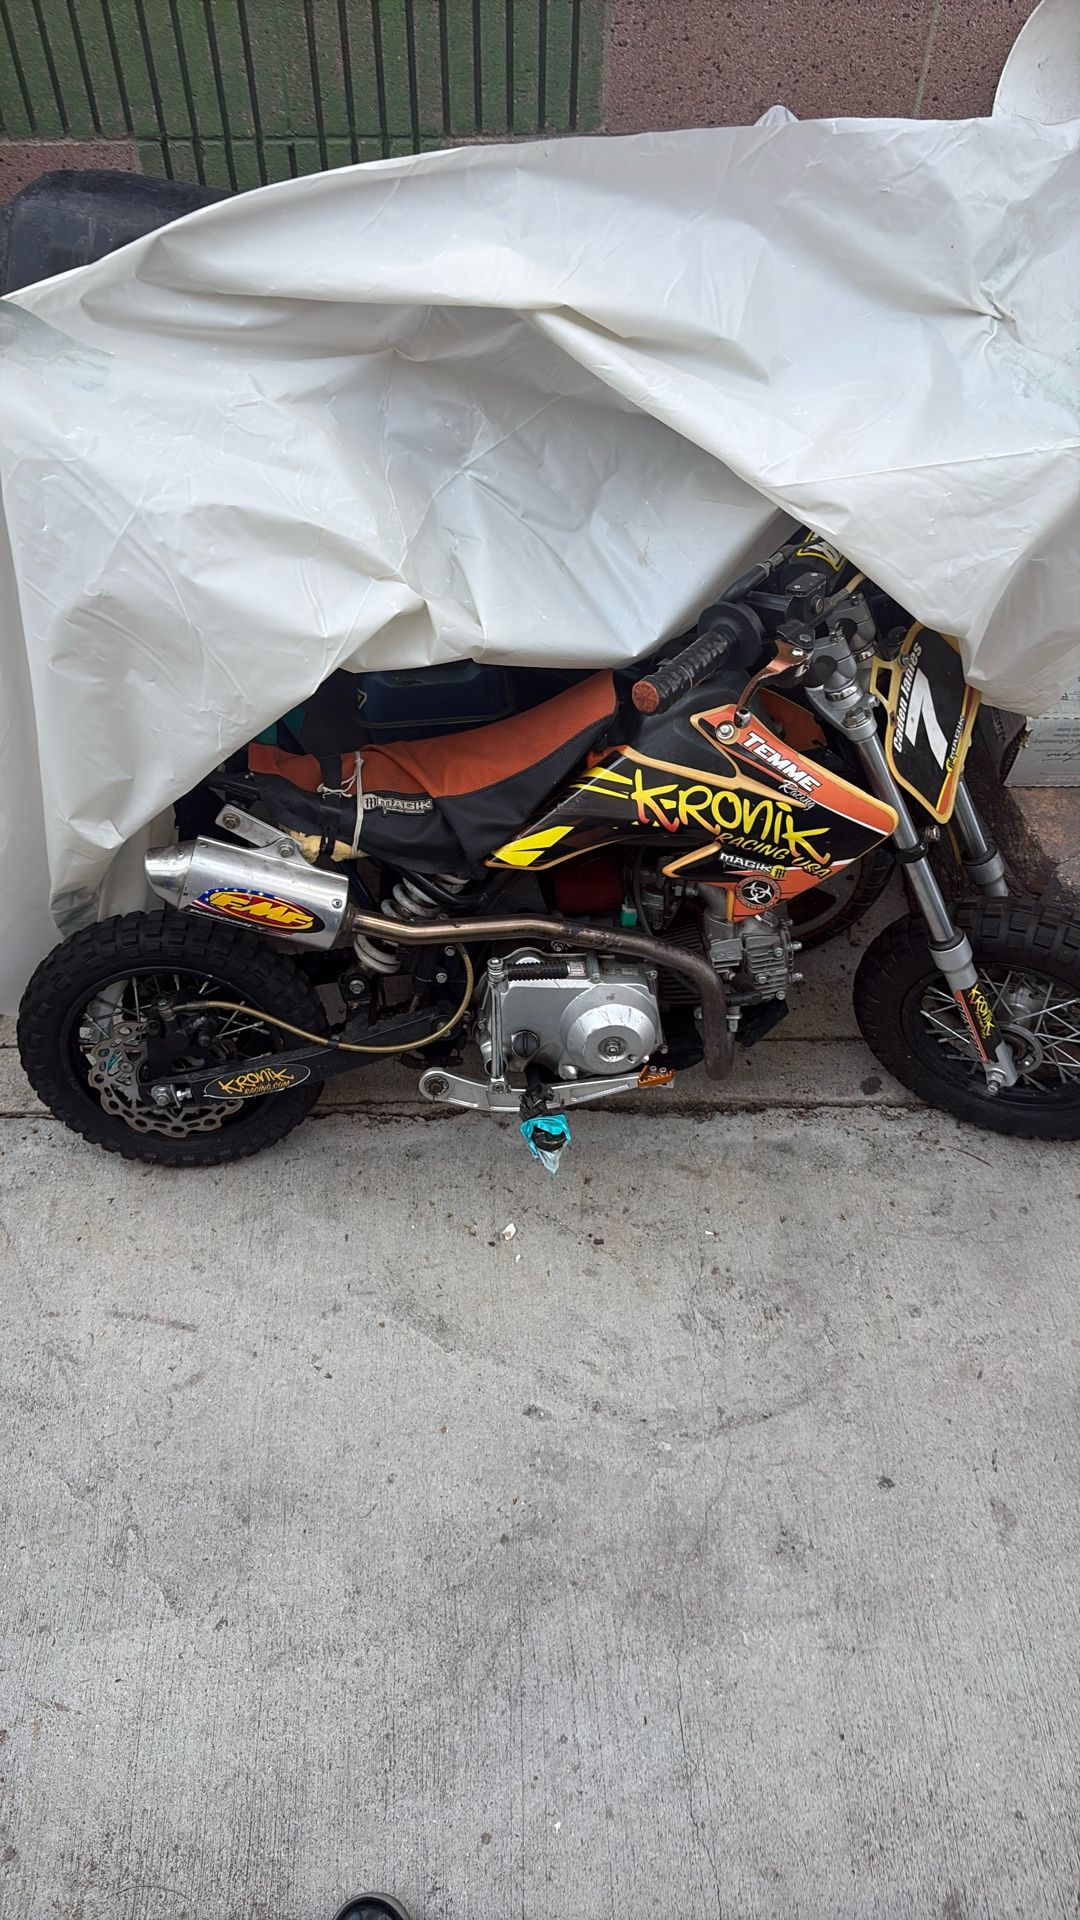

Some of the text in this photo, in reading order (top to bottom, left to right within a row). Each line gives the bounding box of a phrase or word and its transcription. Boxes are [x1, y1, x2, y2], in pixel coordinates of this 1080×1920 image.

[893, 697, 908, 753] Caden
[905, 667, 948, 770] 7
[742, 731, 822, 792] TEMME
[378, 798, 433, 812] MAGIK
[779, 779, 815, 811] Racing
[715, 833, 832, 879] RACING USA
[720, 852, 772, 873] MAGIK
[210, 893, 314, 925] FMF
